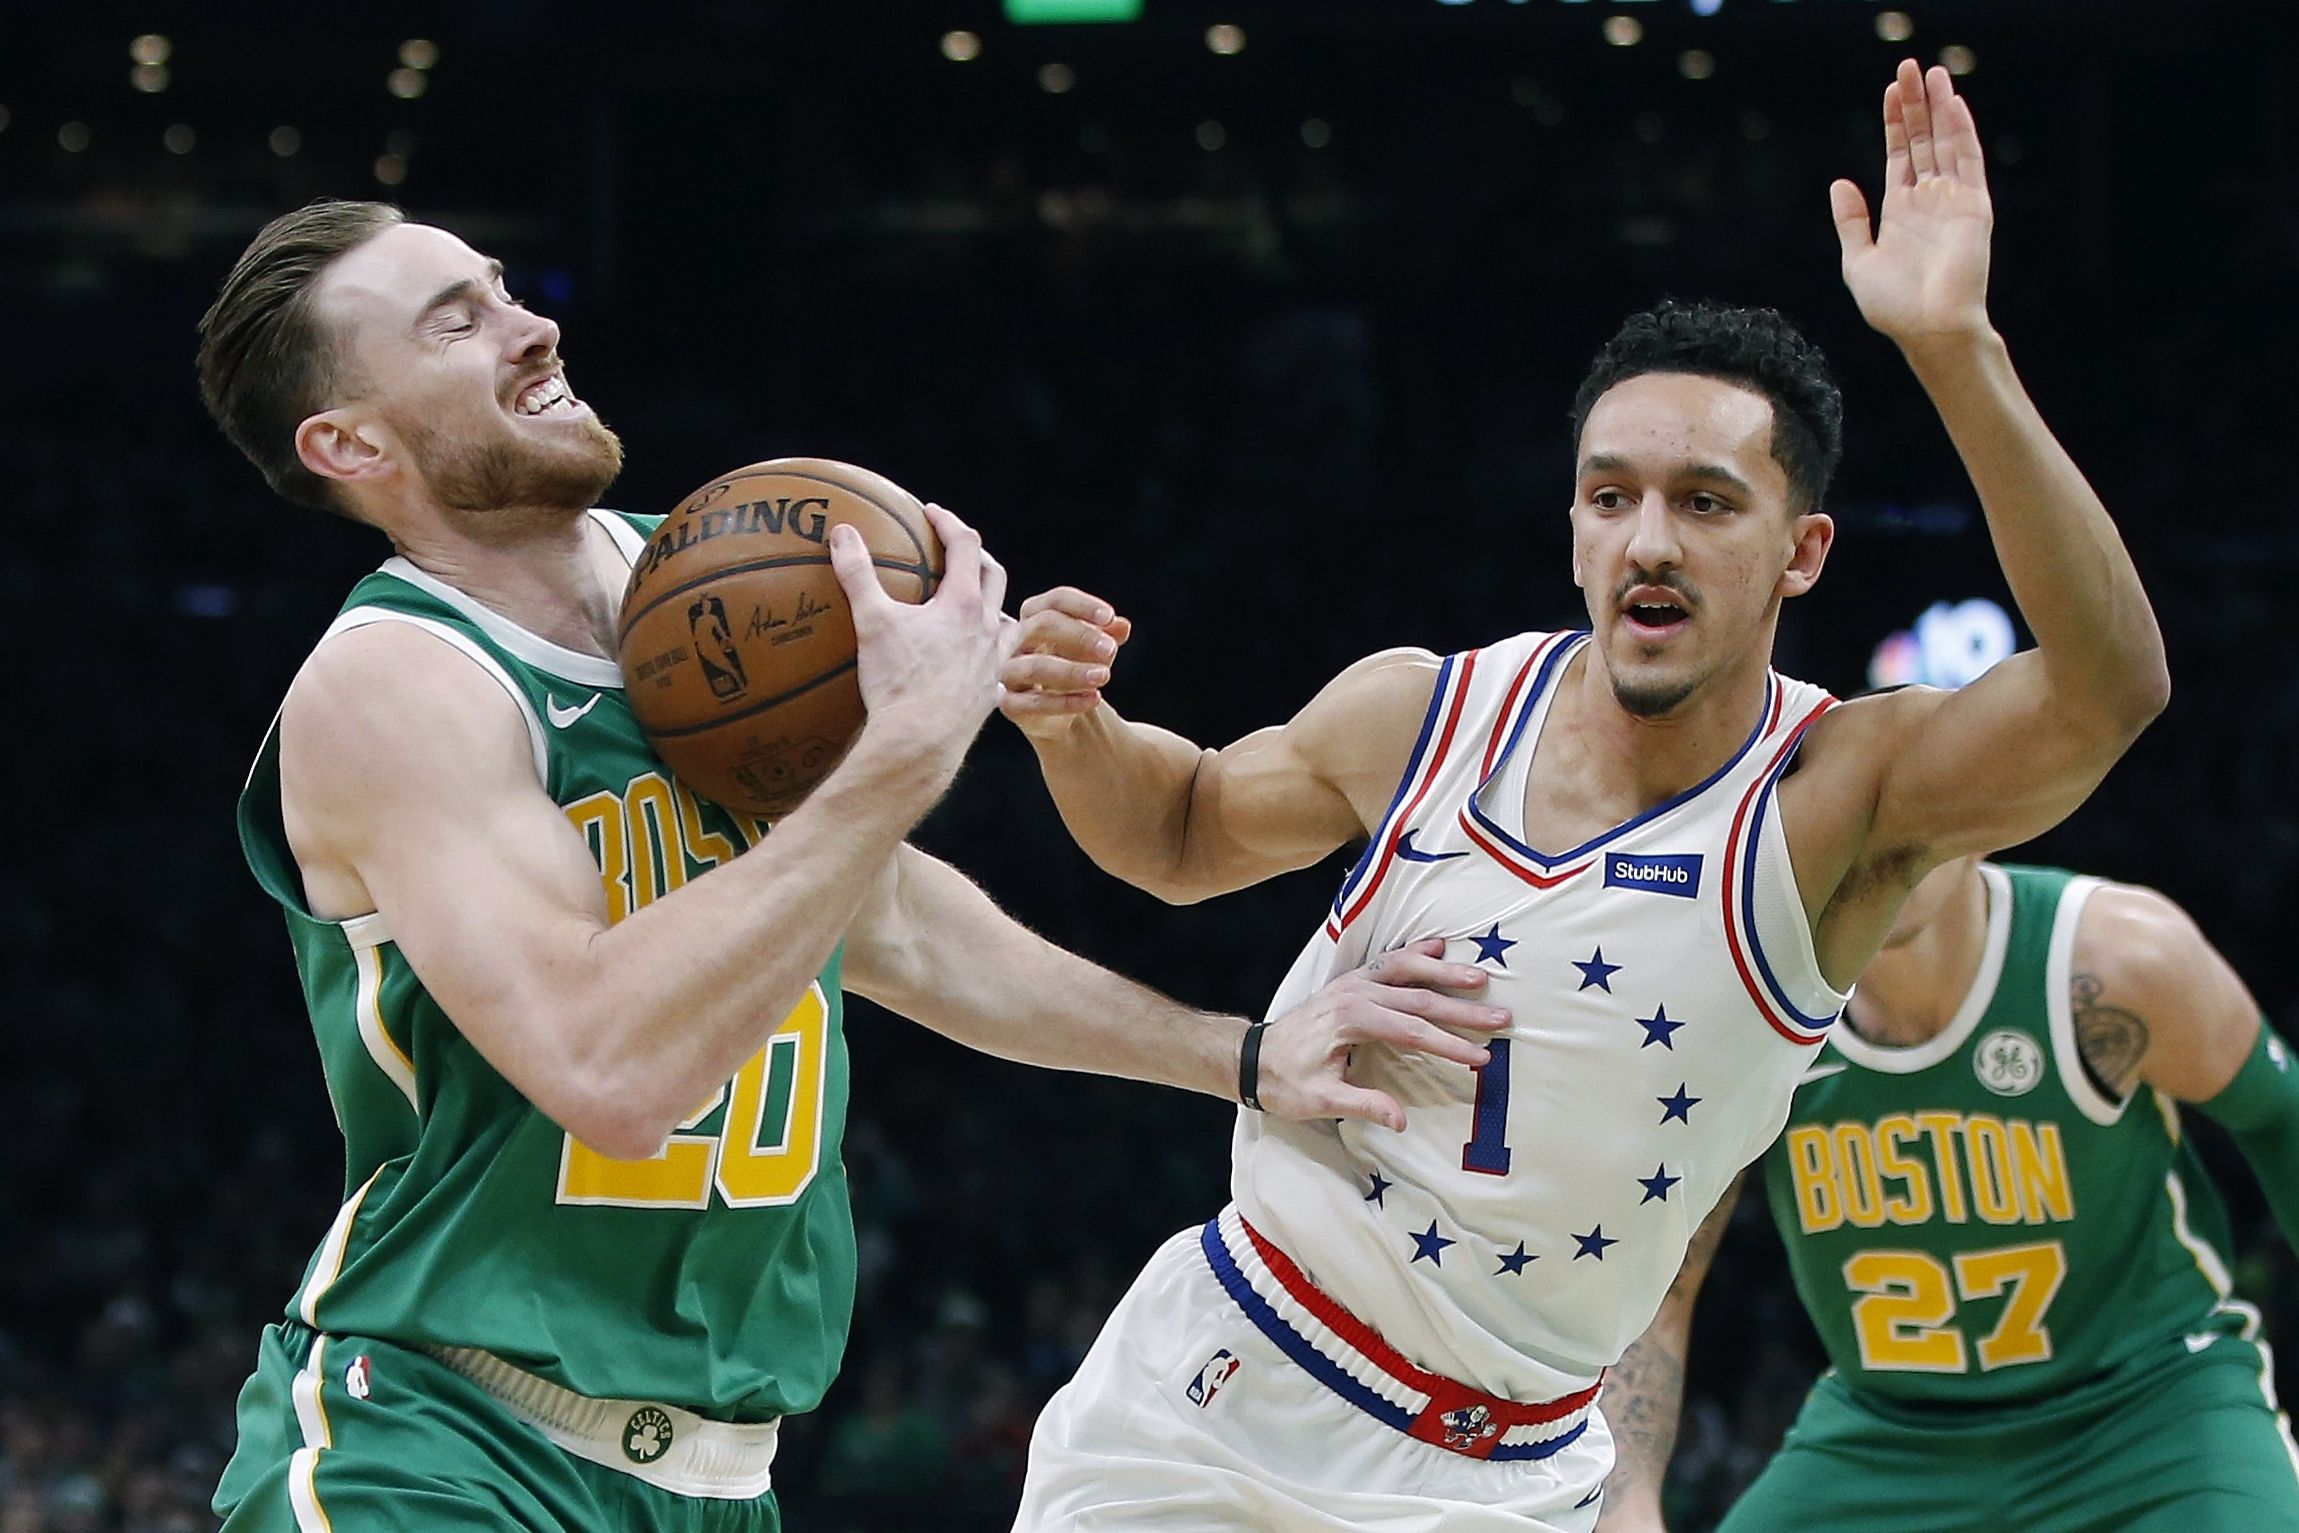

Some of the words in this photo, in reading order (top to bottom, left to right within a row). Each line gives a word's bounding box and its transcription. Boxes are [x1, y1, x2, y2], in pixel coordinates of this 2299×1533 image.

[629, 498, 829, 594] PALDING
[1614, 861, 1689, 884] StubHub
[1461, 1037, 1512, 1177] 1
[1787, 1110, 2075, 1234] BOSTON
[1842, 1240, 2067, 1374] 27
[630, 1410, 672, 1439] CELTICS
